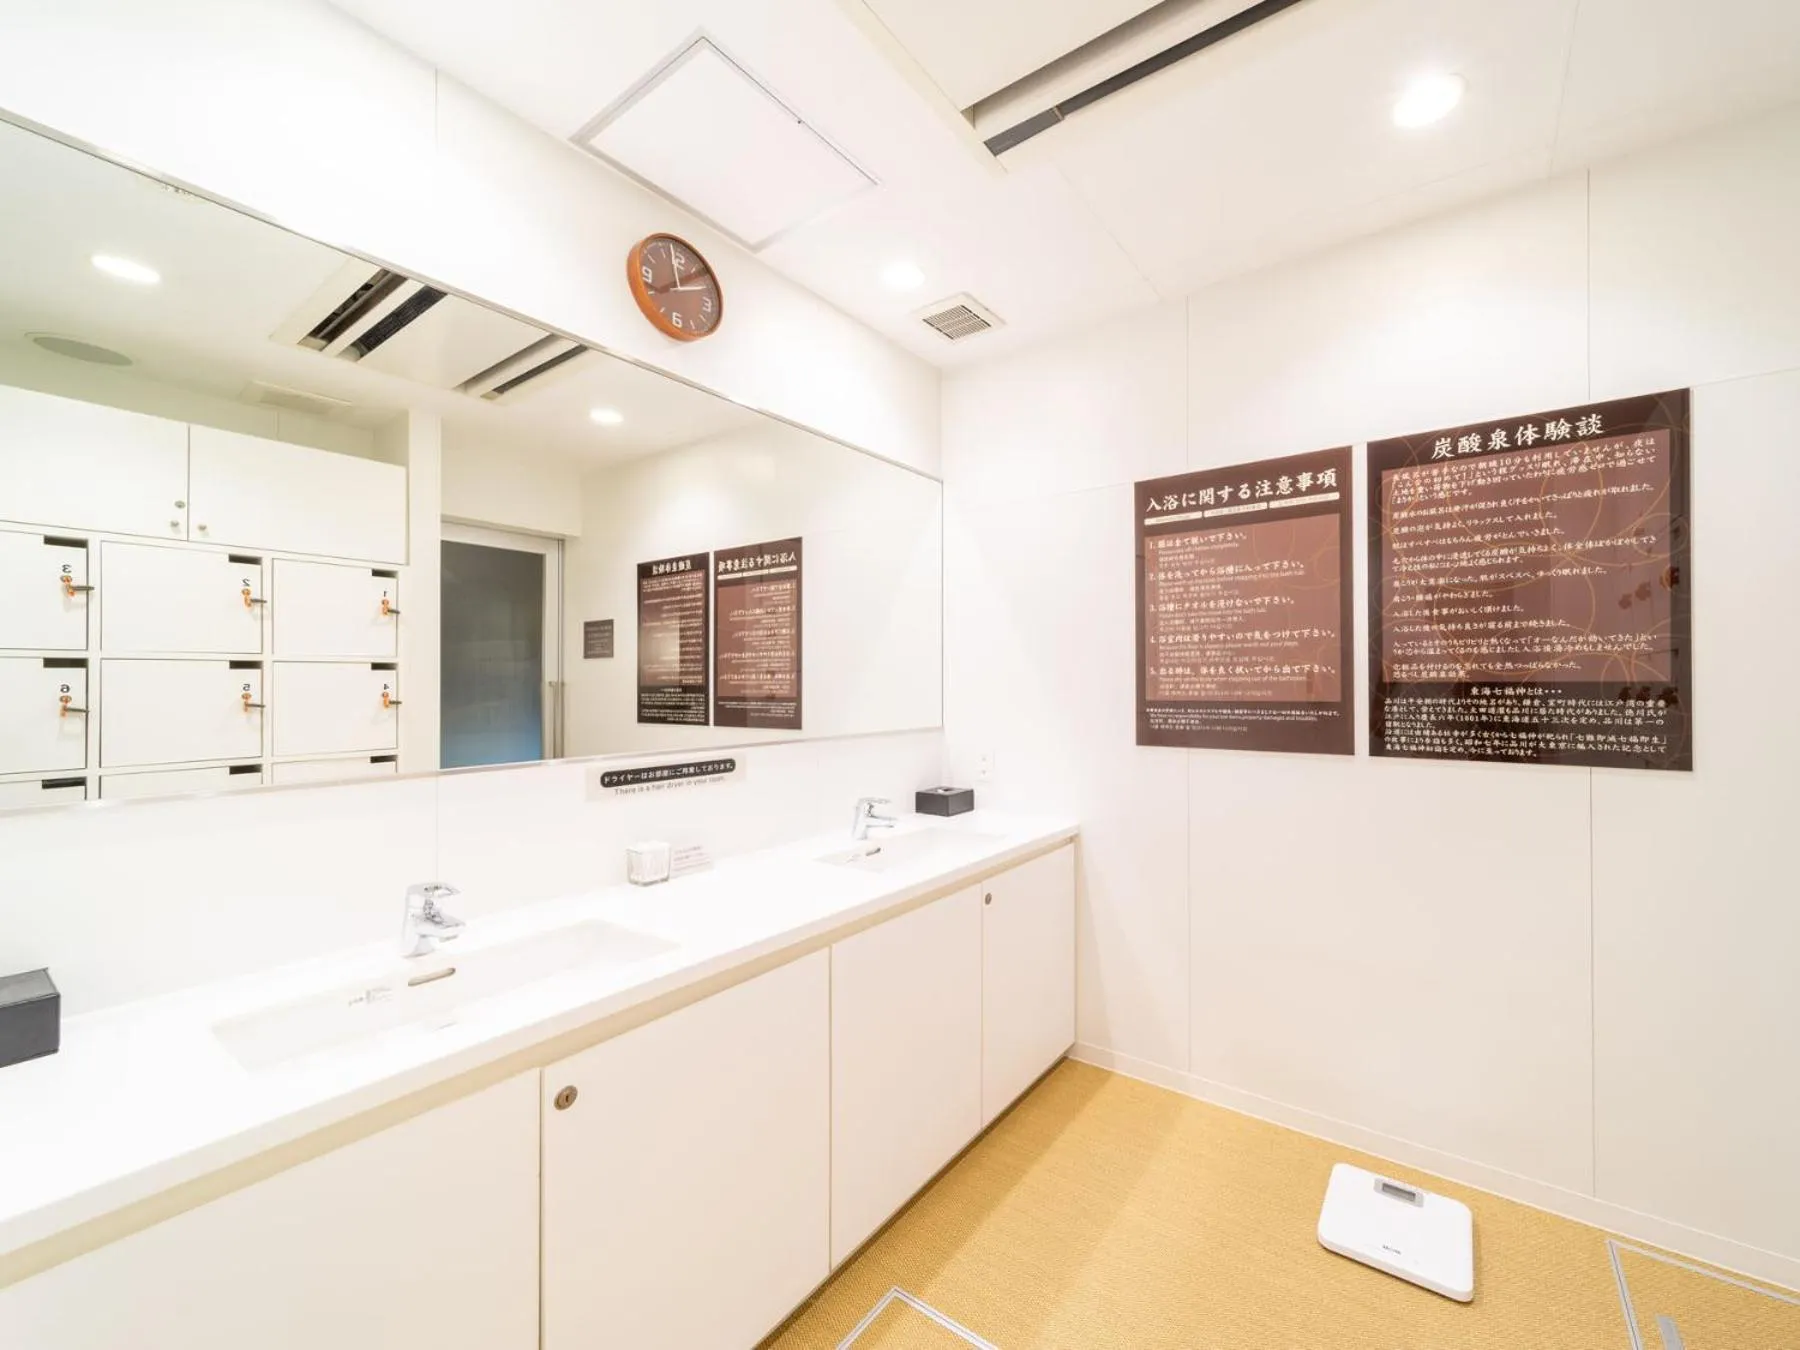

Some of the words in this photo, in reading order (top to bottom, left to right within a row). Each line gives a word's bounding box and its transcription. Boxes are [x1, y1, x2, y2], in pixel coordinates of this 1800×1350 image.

[641, 266, 652, 283] 9
[702, 296, 713, 312] 3
[672, 312, 682, 328] 6
[1431, 410, 1605, 460] 炭酸泉体験談
[1145, 467, 1337, 514] 入浴に関する注意事項
